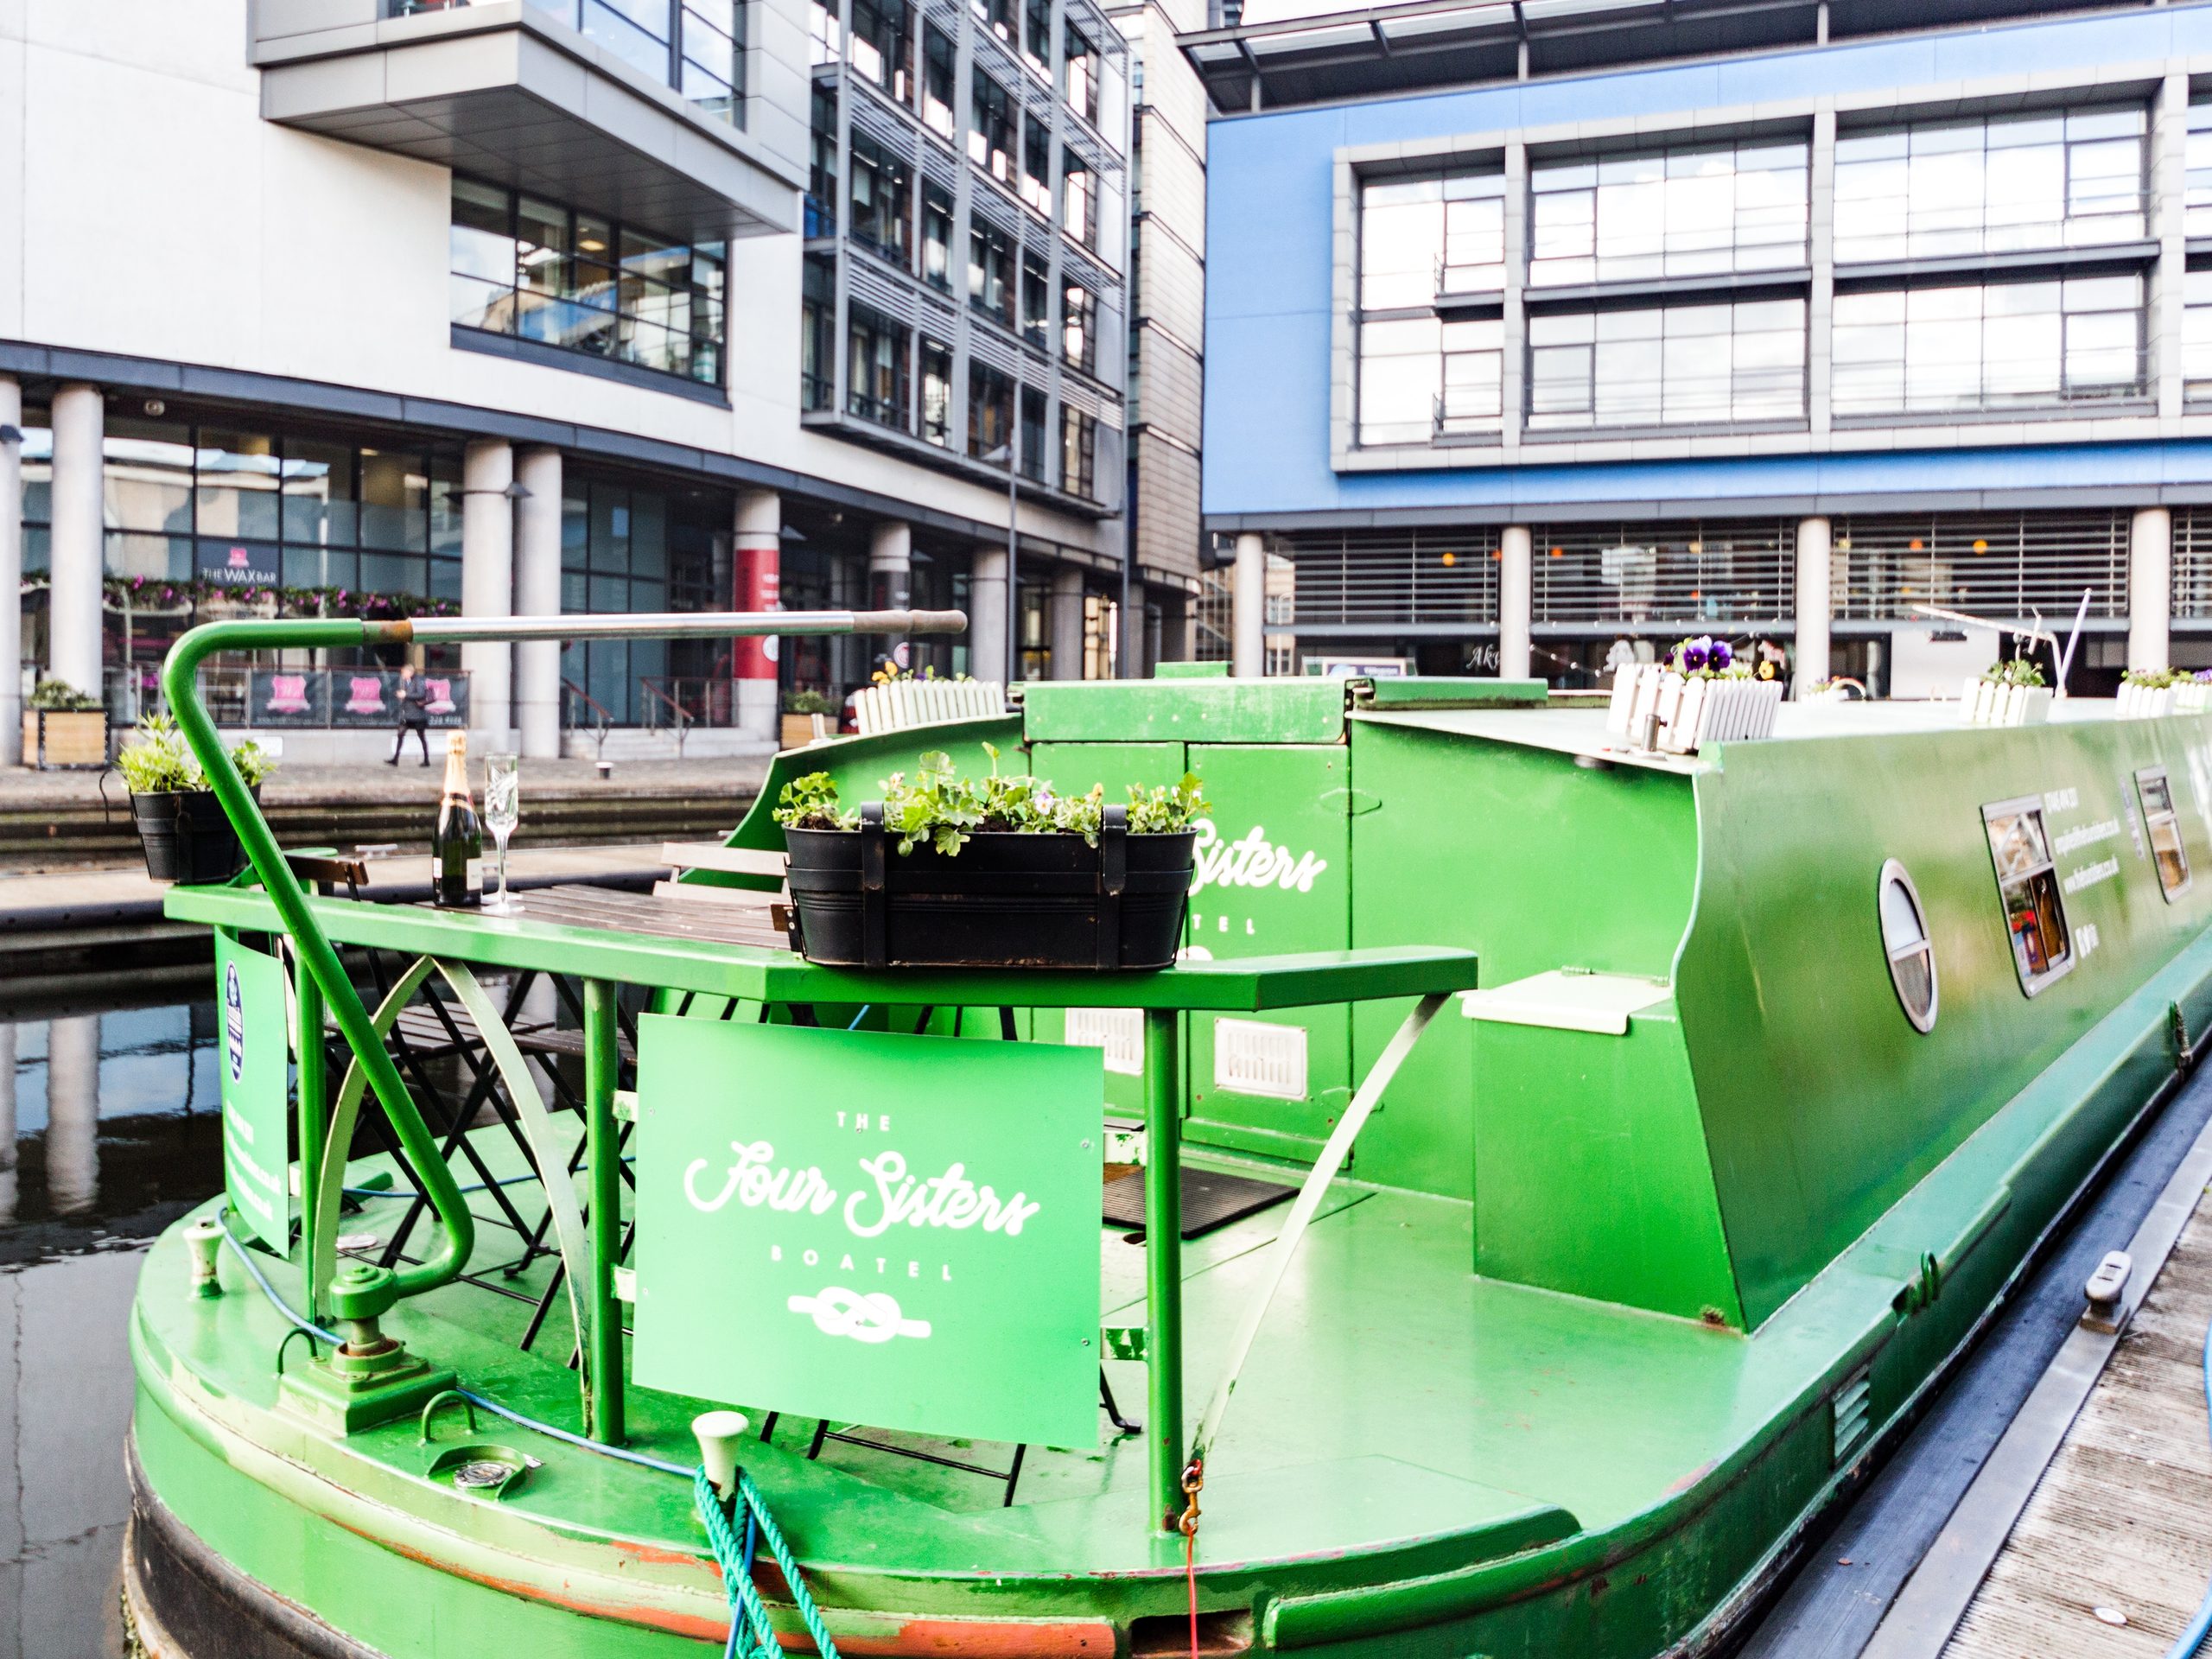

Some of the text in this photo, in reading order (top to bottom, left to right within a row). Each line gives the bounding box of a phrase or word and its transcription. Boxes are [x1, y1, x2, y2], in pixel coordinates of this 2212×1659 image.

[202, 568, 276, 584] THE WAX BAR
[1188, 818, 1328, 895] Sisters
[1192, 913, 1255, 935] TEL
[837, 1111, 890, 1131] THE
[685, 1141, 1040, 1237] Four Sisters
[771, 1245, 952, 1281] BOATEL
